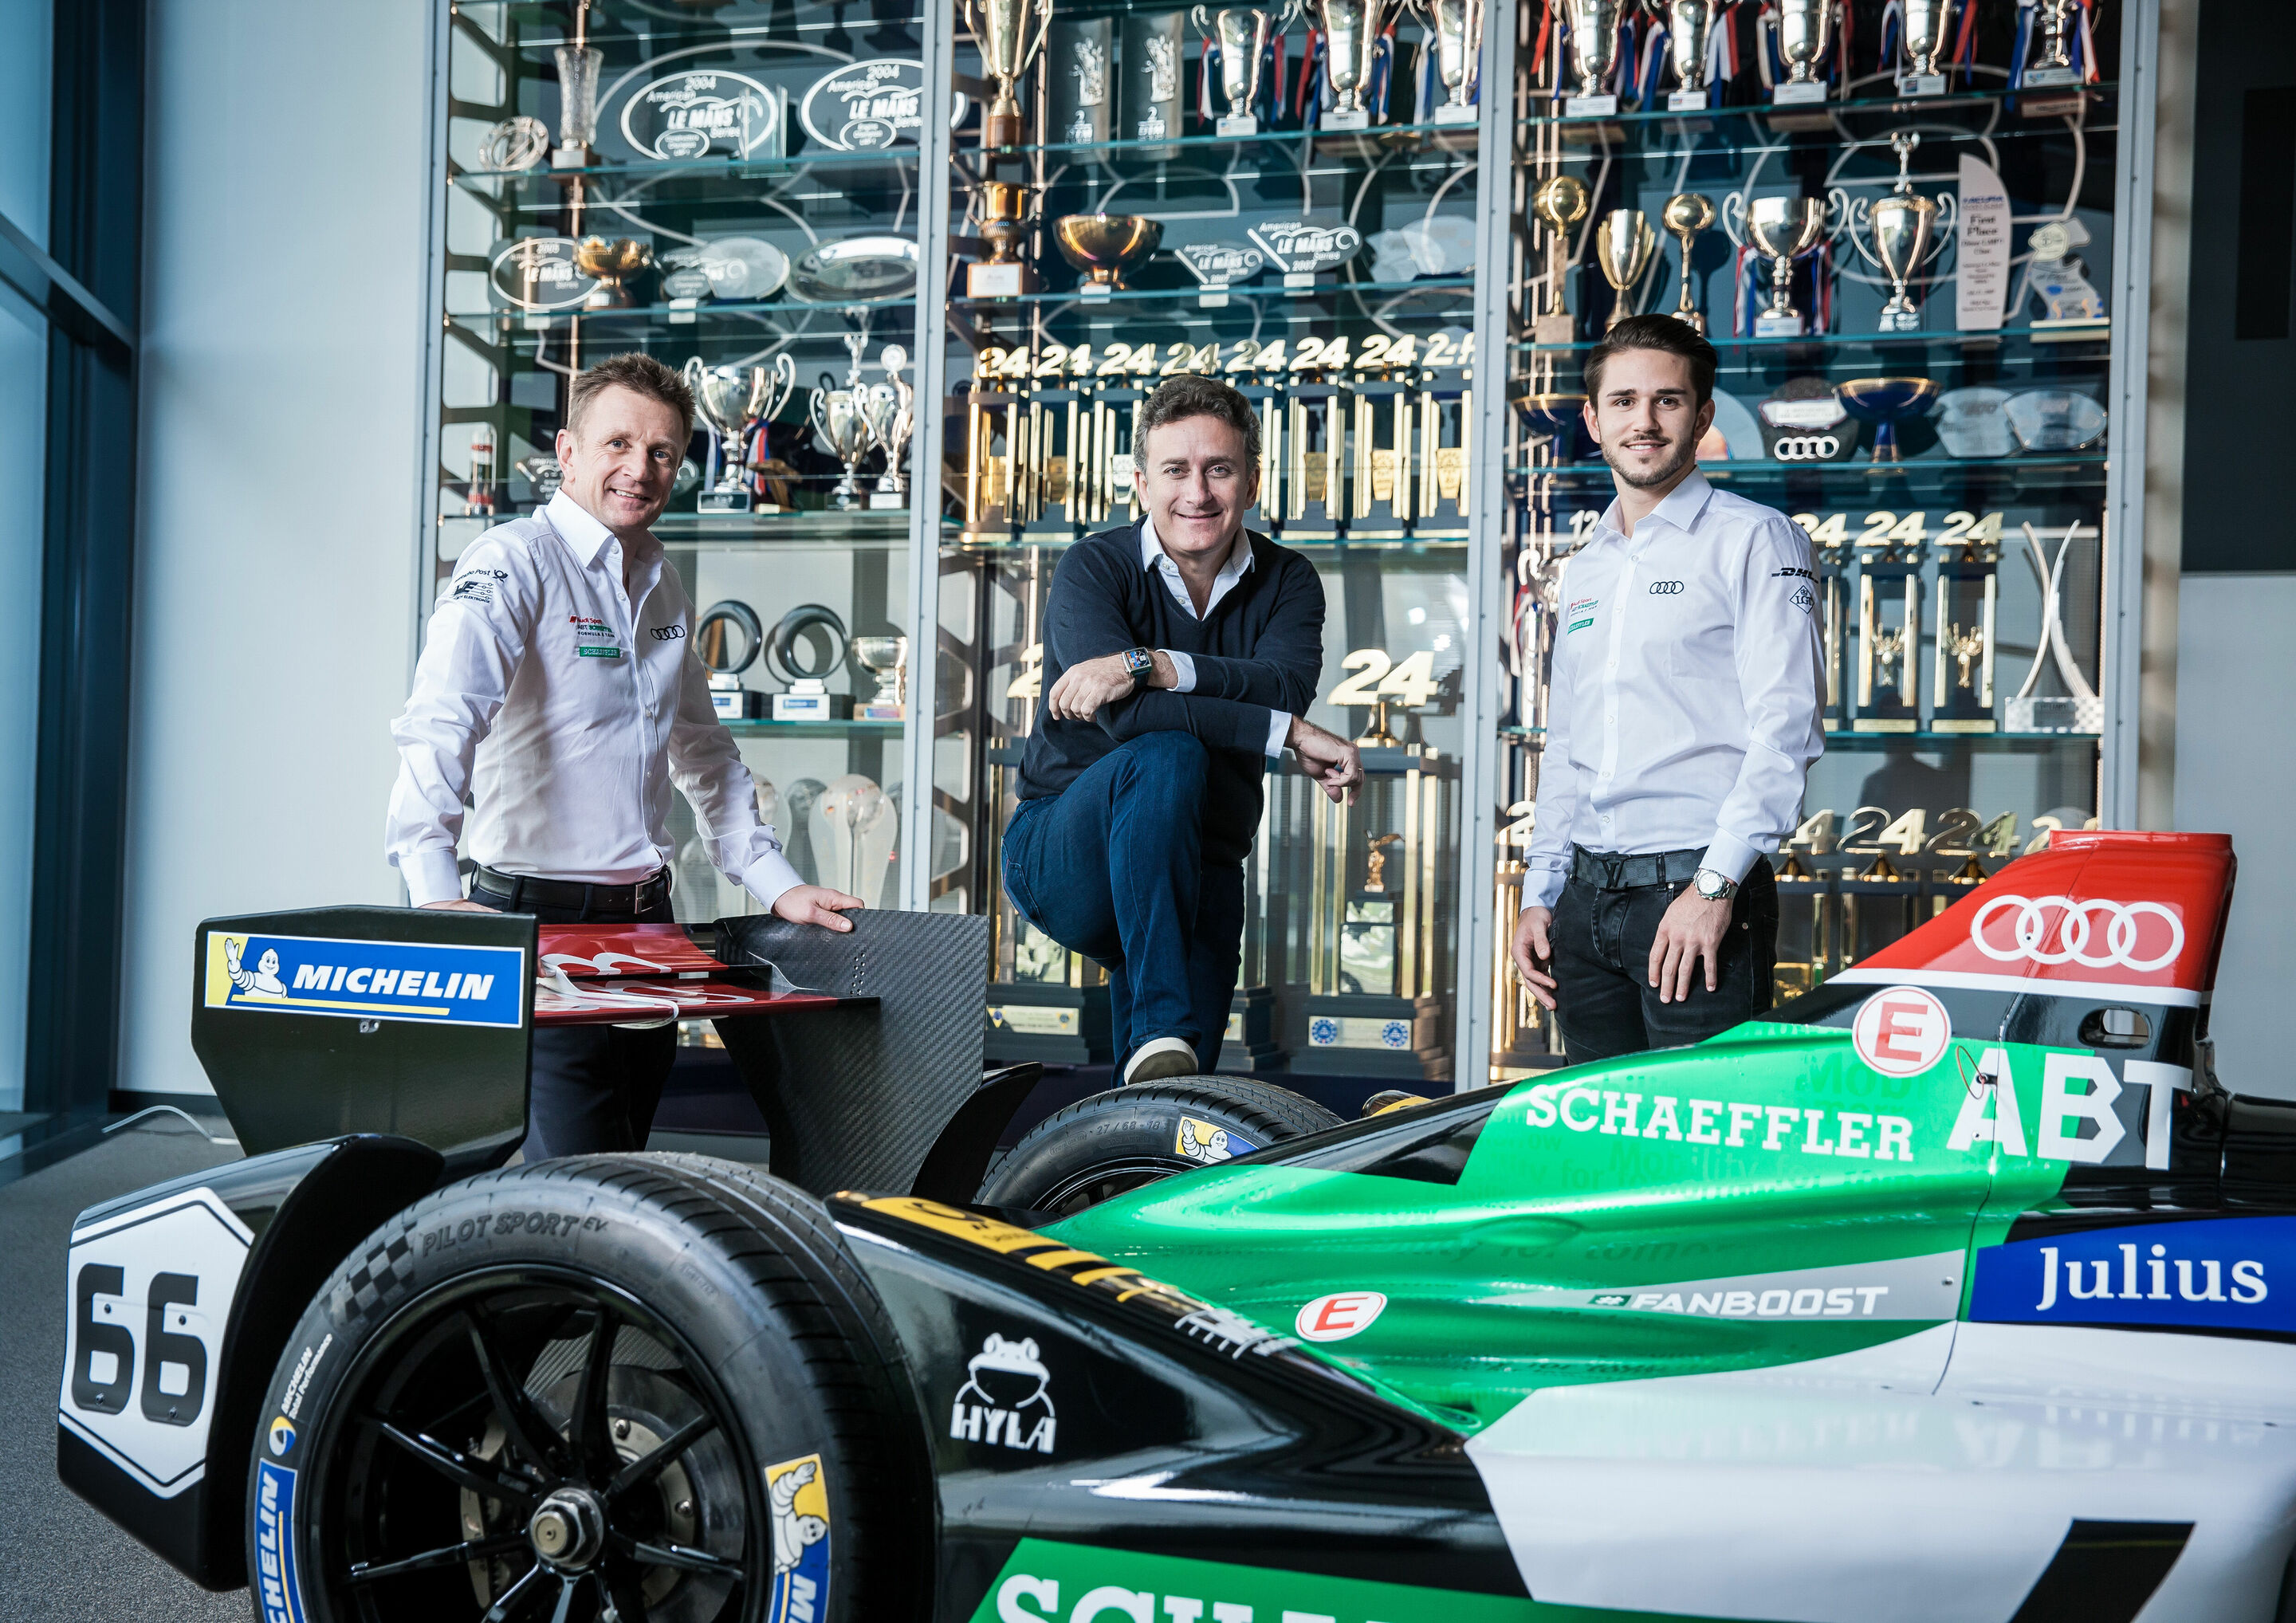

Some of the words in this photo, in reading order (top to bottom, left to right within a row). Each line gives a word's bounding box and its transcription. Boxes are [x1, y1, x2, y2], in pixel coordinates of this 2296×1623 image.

[683, 76, 717, 91] 2004
[827, 78, 879, 92] American
[866, 65, 900, 81] 2004
[646, 89, 697, 103] American
[849, 100, 870, 120] LE
[666, 110, 687, 130] LE
[1260, 222, 1302, 233] American
[1197, 257, 1213, 270] LE
[1276, 238, 1294, 254] LE
[978, 346, 1031, 378] 24
[1036, 344, 1093, 377] 24
[1096, 343, 1158, 376] 24
[1159, 342, 1221, 376] 24
[1225, 339, 1288, 373] 24
[1288, 336, 1350, 372] 24
[1353, 334, 1417, 369] 24
[1854, 512, 1926, 548] 24
[1933, 511, 2004, 546] 24
[1780, 567, 1814, 581] DHL
[1327, 649, 1440, 707] 24
[1836, 805, 1928, 855] 24
[1924, 806, 2022, 859] 24
[292, 963, 494, 1001] MICHELIN
[1873, 1001, 1928, 1063] E
[1525, 1084, 1913, 1162] SCHAEFFLER
[1946, 1047, 2193, 1171] ABT
[423, 1214, 492, 1257] PILOT
[493, 1210, 580, 1238] SPORT
[2035, 1244, 2269, 1312] Julius
[1313, 1297, 1370, 1332] E
[71, 1262, 207, 1428] 66
[949, 1402, 1057, 1454] HYLA
